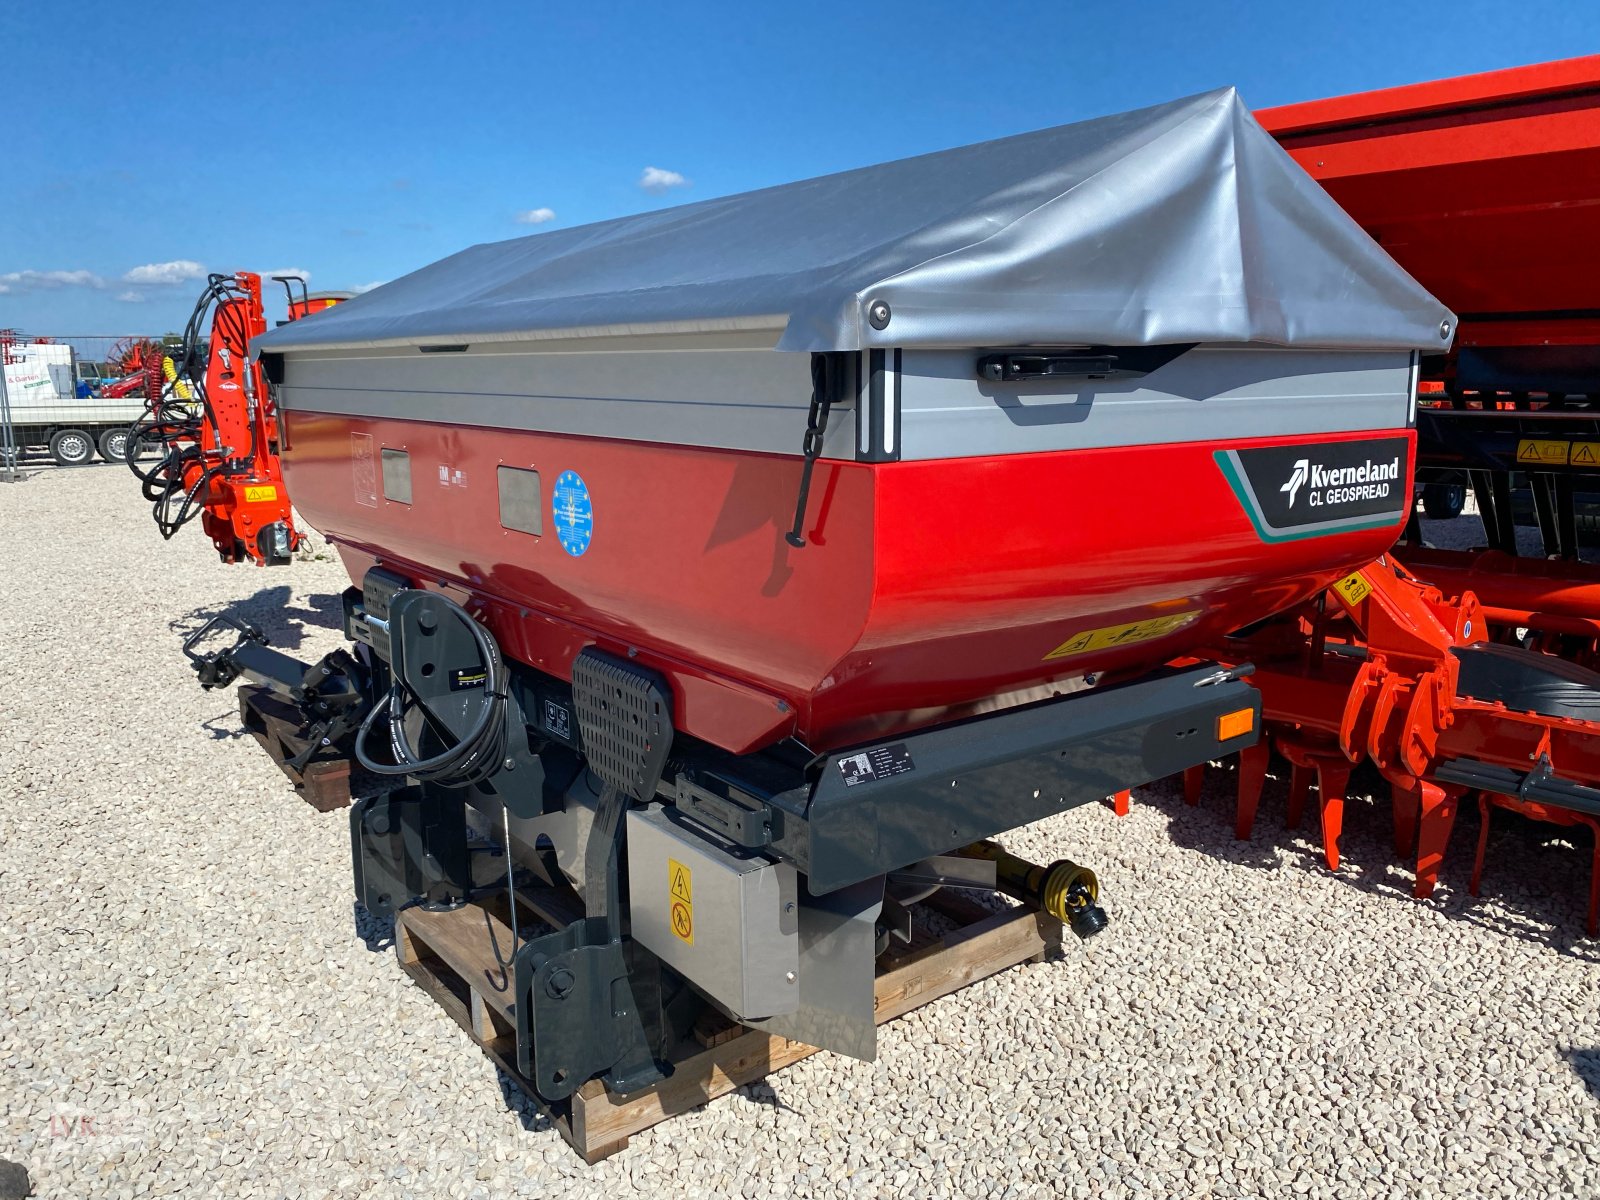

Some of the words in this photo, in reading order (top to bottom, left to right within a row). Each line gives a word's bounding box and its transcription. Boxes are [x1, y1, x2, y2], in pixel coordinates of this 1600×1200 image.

[15, 374, 39, 383] Garten
[1310, 457, 1399, 488] Kverneland
[1309, 491, 1324, 507] CL
[1326, 483, 1390, 505] GEOSPREAD
